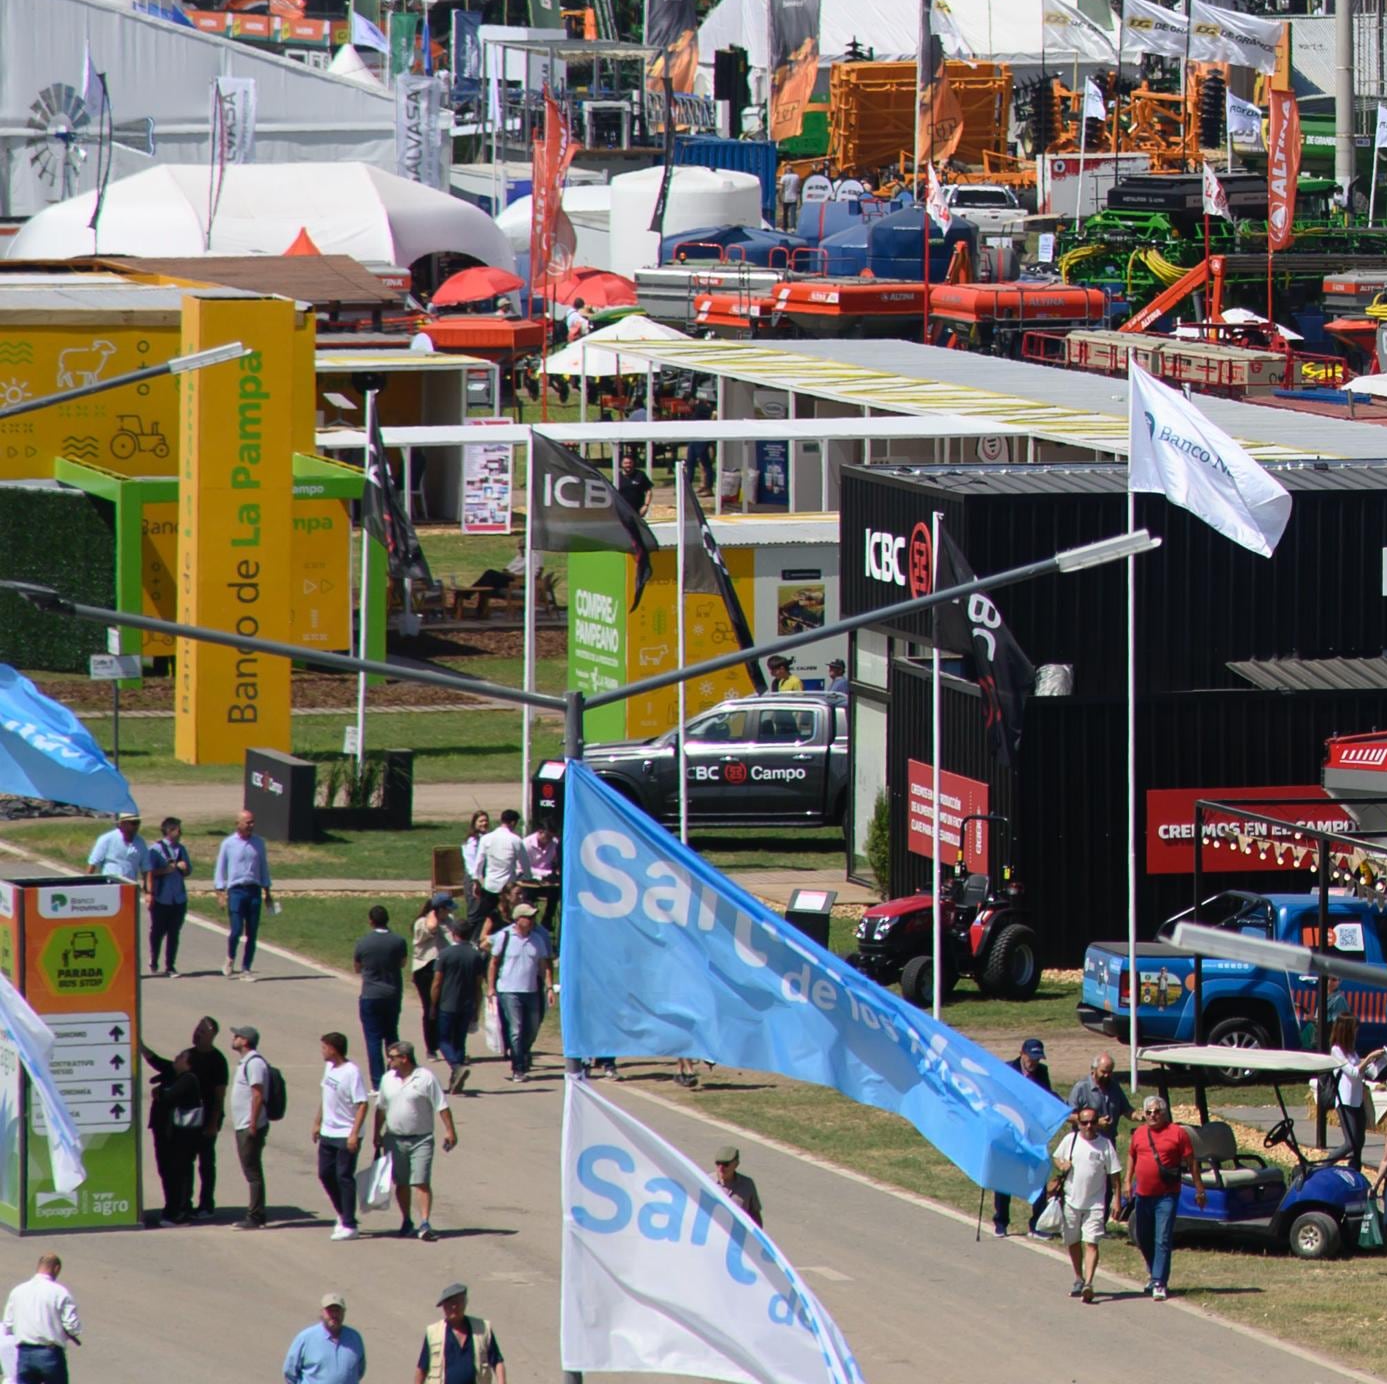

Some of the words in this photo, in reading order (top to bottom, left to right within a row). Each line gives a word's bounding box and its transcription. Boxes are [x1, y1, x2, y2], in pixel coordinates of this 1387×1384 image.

[1271, 99, 1292, 200] ALTINA
[230, 350, 271, 490] Pampa
[1159, 425, 1211, 465] Banco
[543, 473, 614, 510] ICB
[230, 502, 261, 548] La
[864, 527, 907, 587] ICBC
[227, 559, 260, 605] de
[575, 619, 619, 653] PAMPEANO
[227, 615, 260, 727] Banco
[686, 765, 720, 780] CBC
[750, 765, 807, 782] Campo
[70, 904, 109, 912] Provincia
[57, 968, 104, 978] PARADA
[58, 979, 78, 988] BUS
[79, 978, 104, 987] STOP
[780, 966, 839, 1010] de
[92, 1200, 129, 1216] agro
